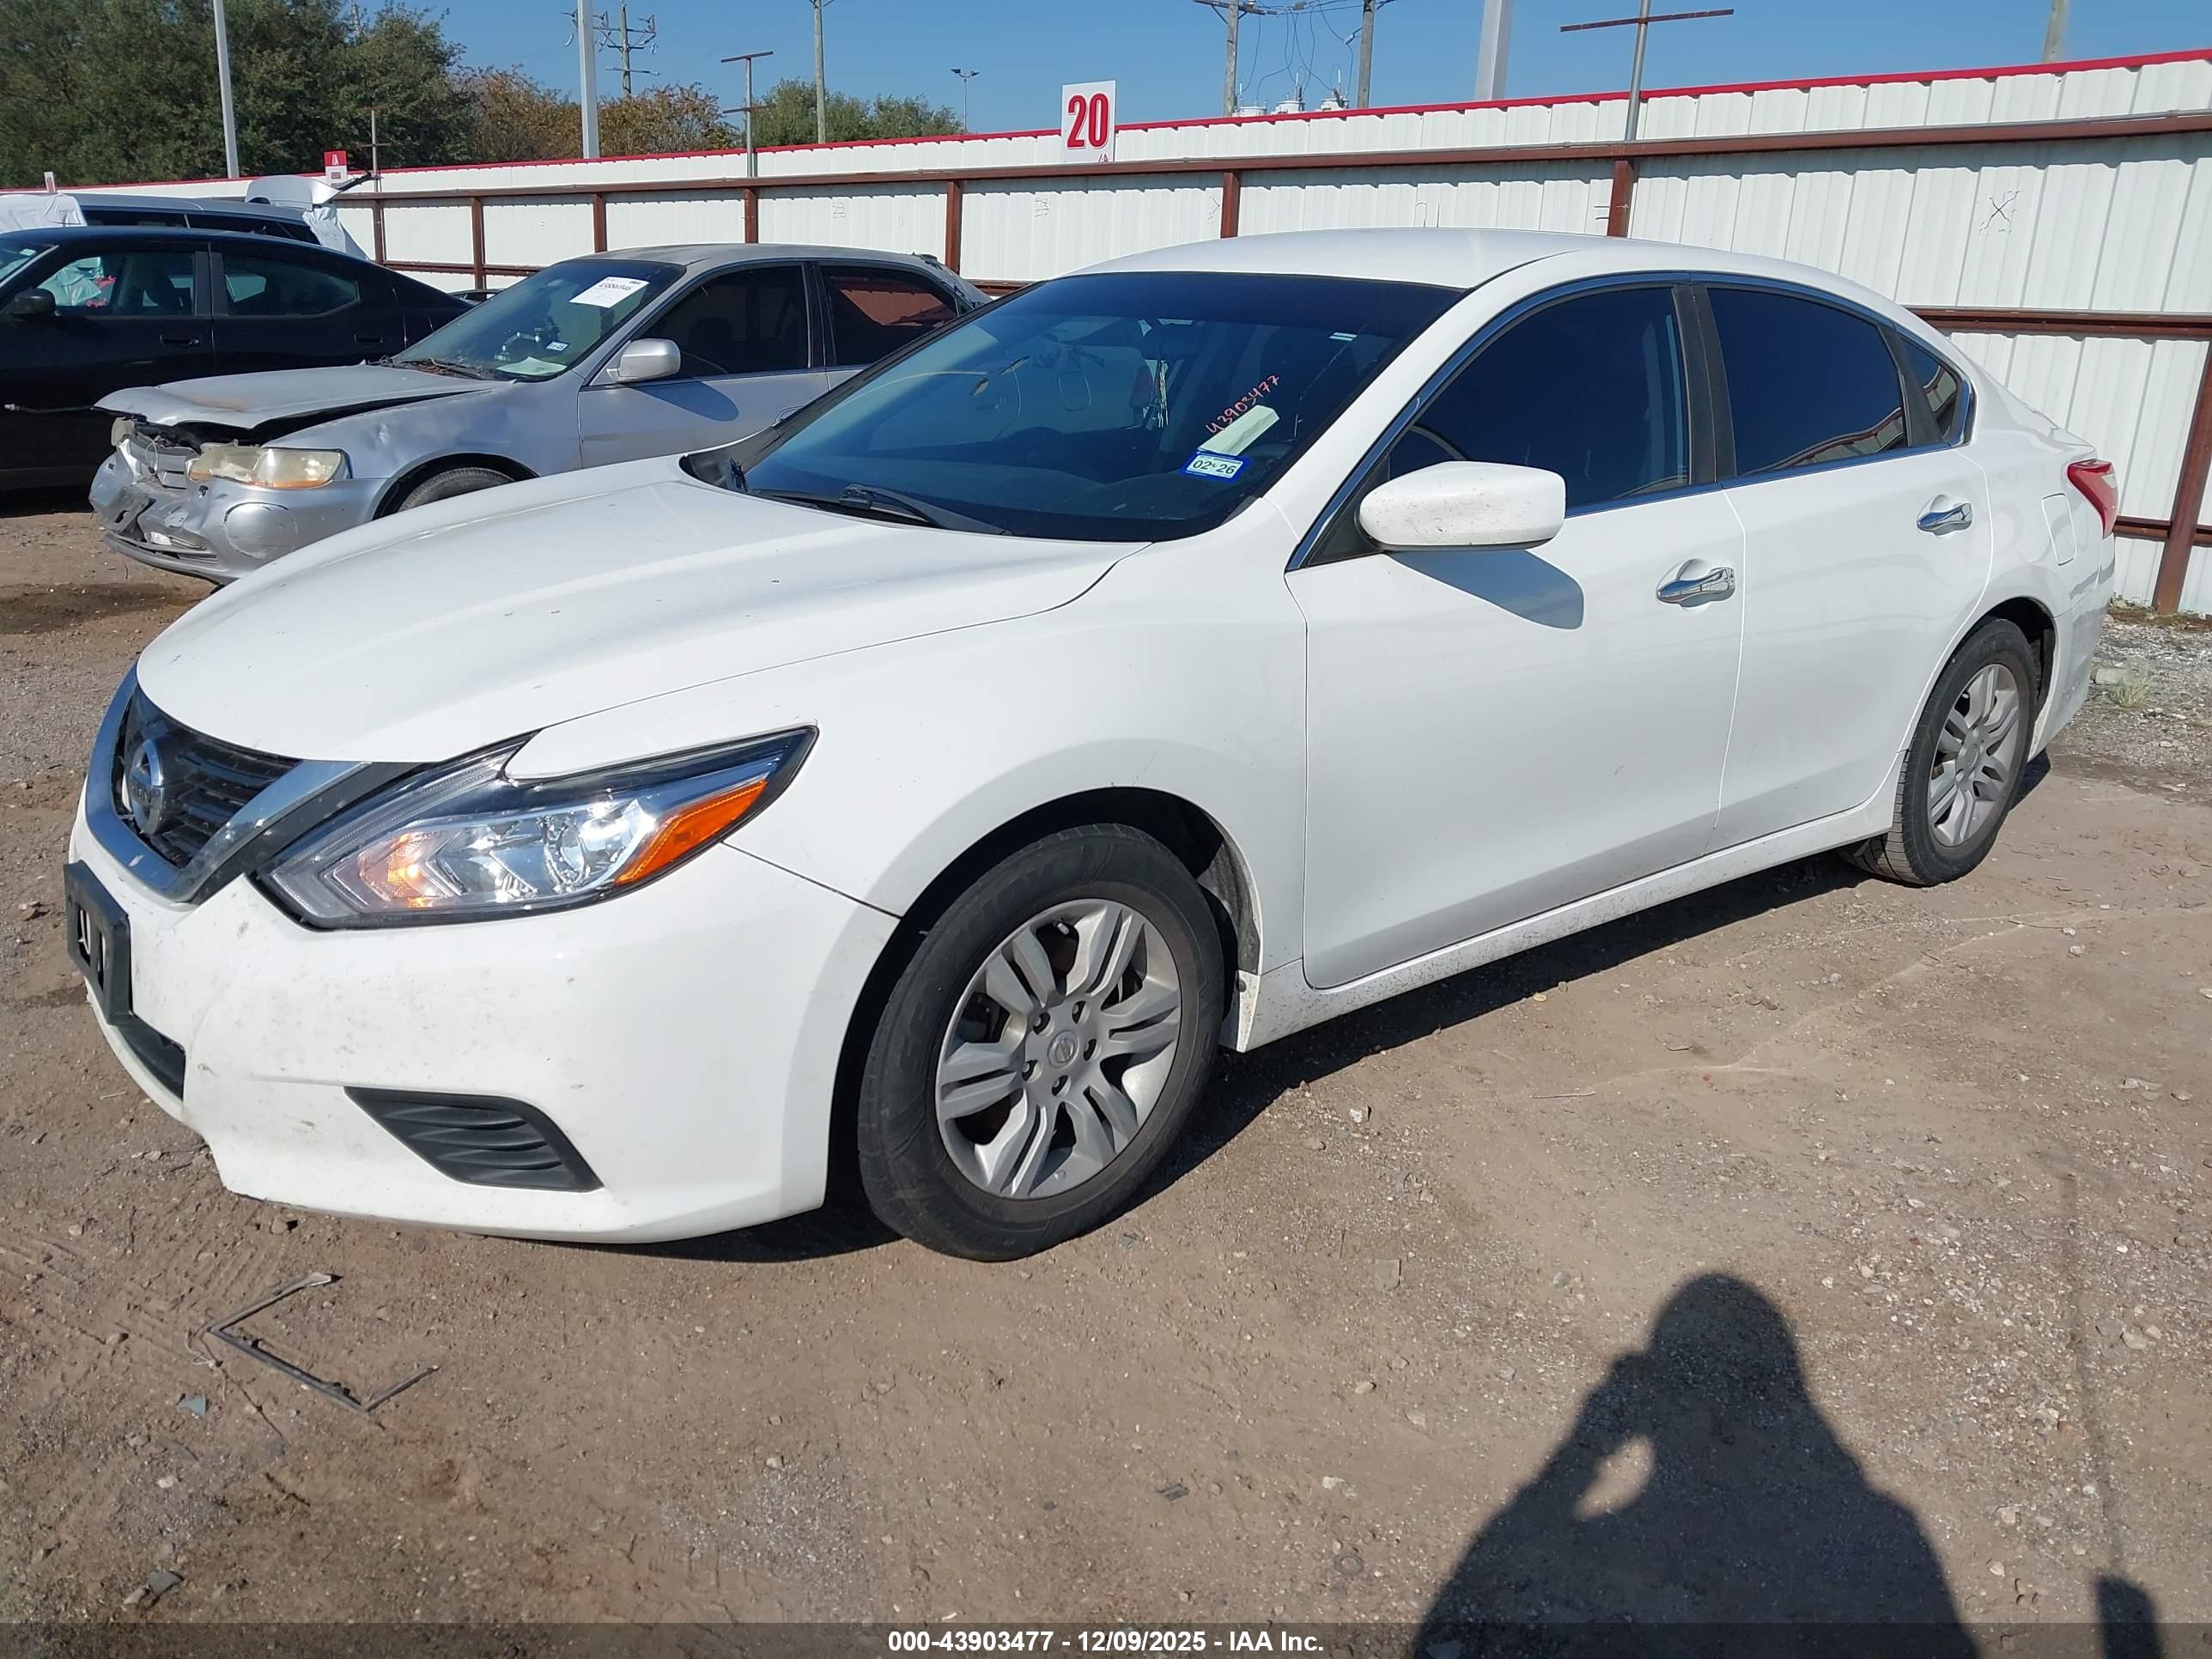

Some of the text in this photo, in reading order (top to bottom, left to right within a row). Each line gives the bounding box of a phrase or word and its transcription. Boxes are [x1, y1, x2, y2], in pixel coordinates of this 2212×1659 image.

[1066, 93, 1109, 149] 20
[1205, 375, 1279, 433] 43903477
[1193, 459, 1237, 475] 02 26
